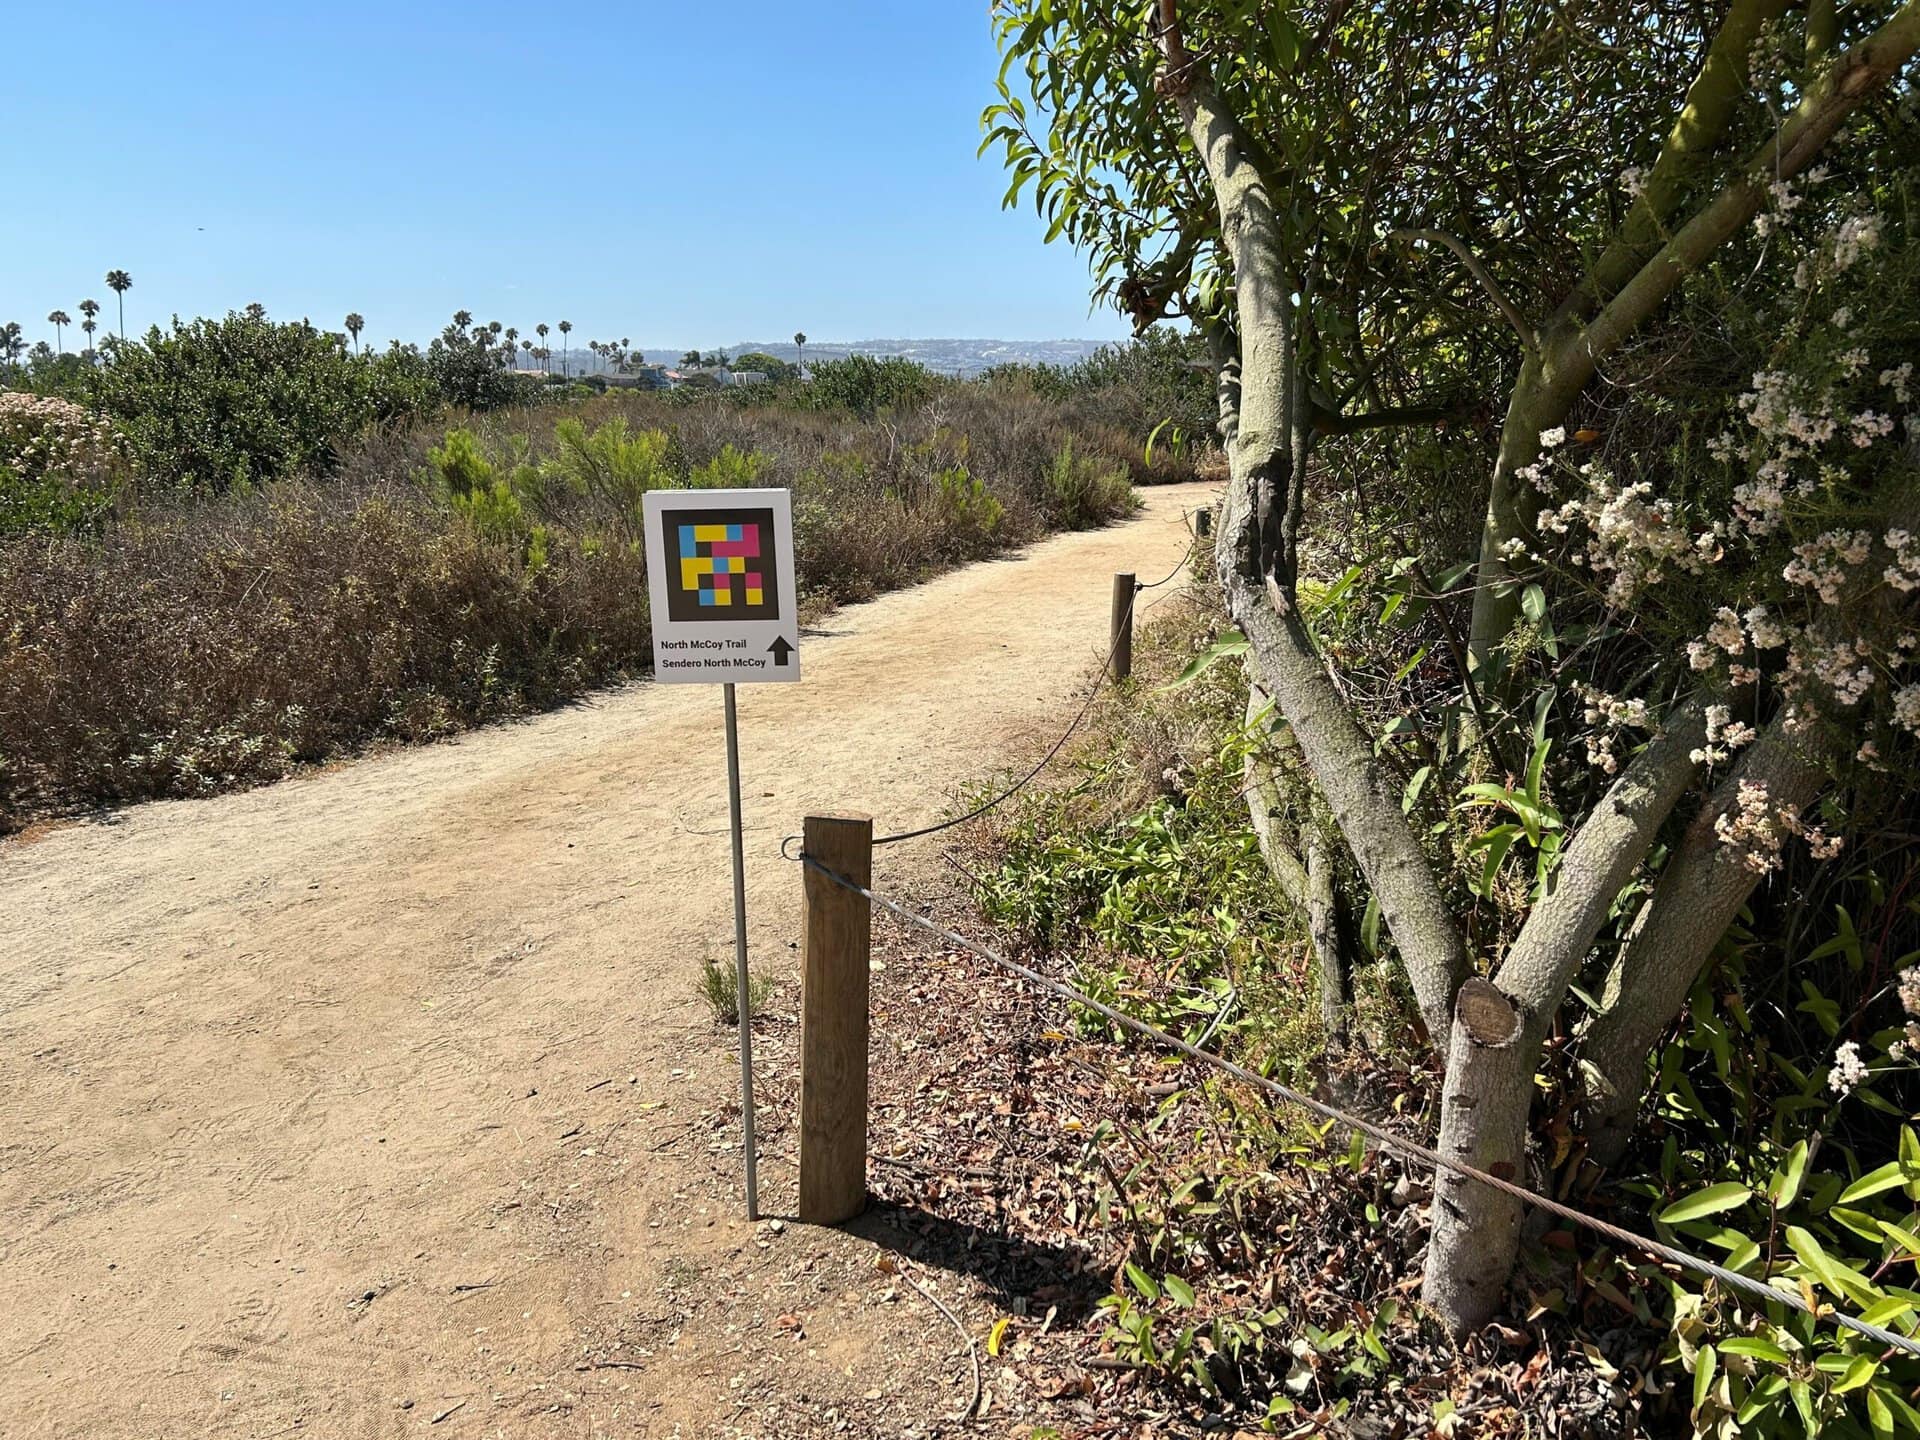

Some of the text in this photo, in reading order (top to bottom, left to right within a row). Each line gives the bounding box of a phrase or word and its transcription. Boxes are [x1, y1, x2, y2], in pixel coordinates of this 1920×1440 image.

[661, 639, 747, 650] North McCoy Trail
[662, 658, 766, 669] Sendero North McCoy
